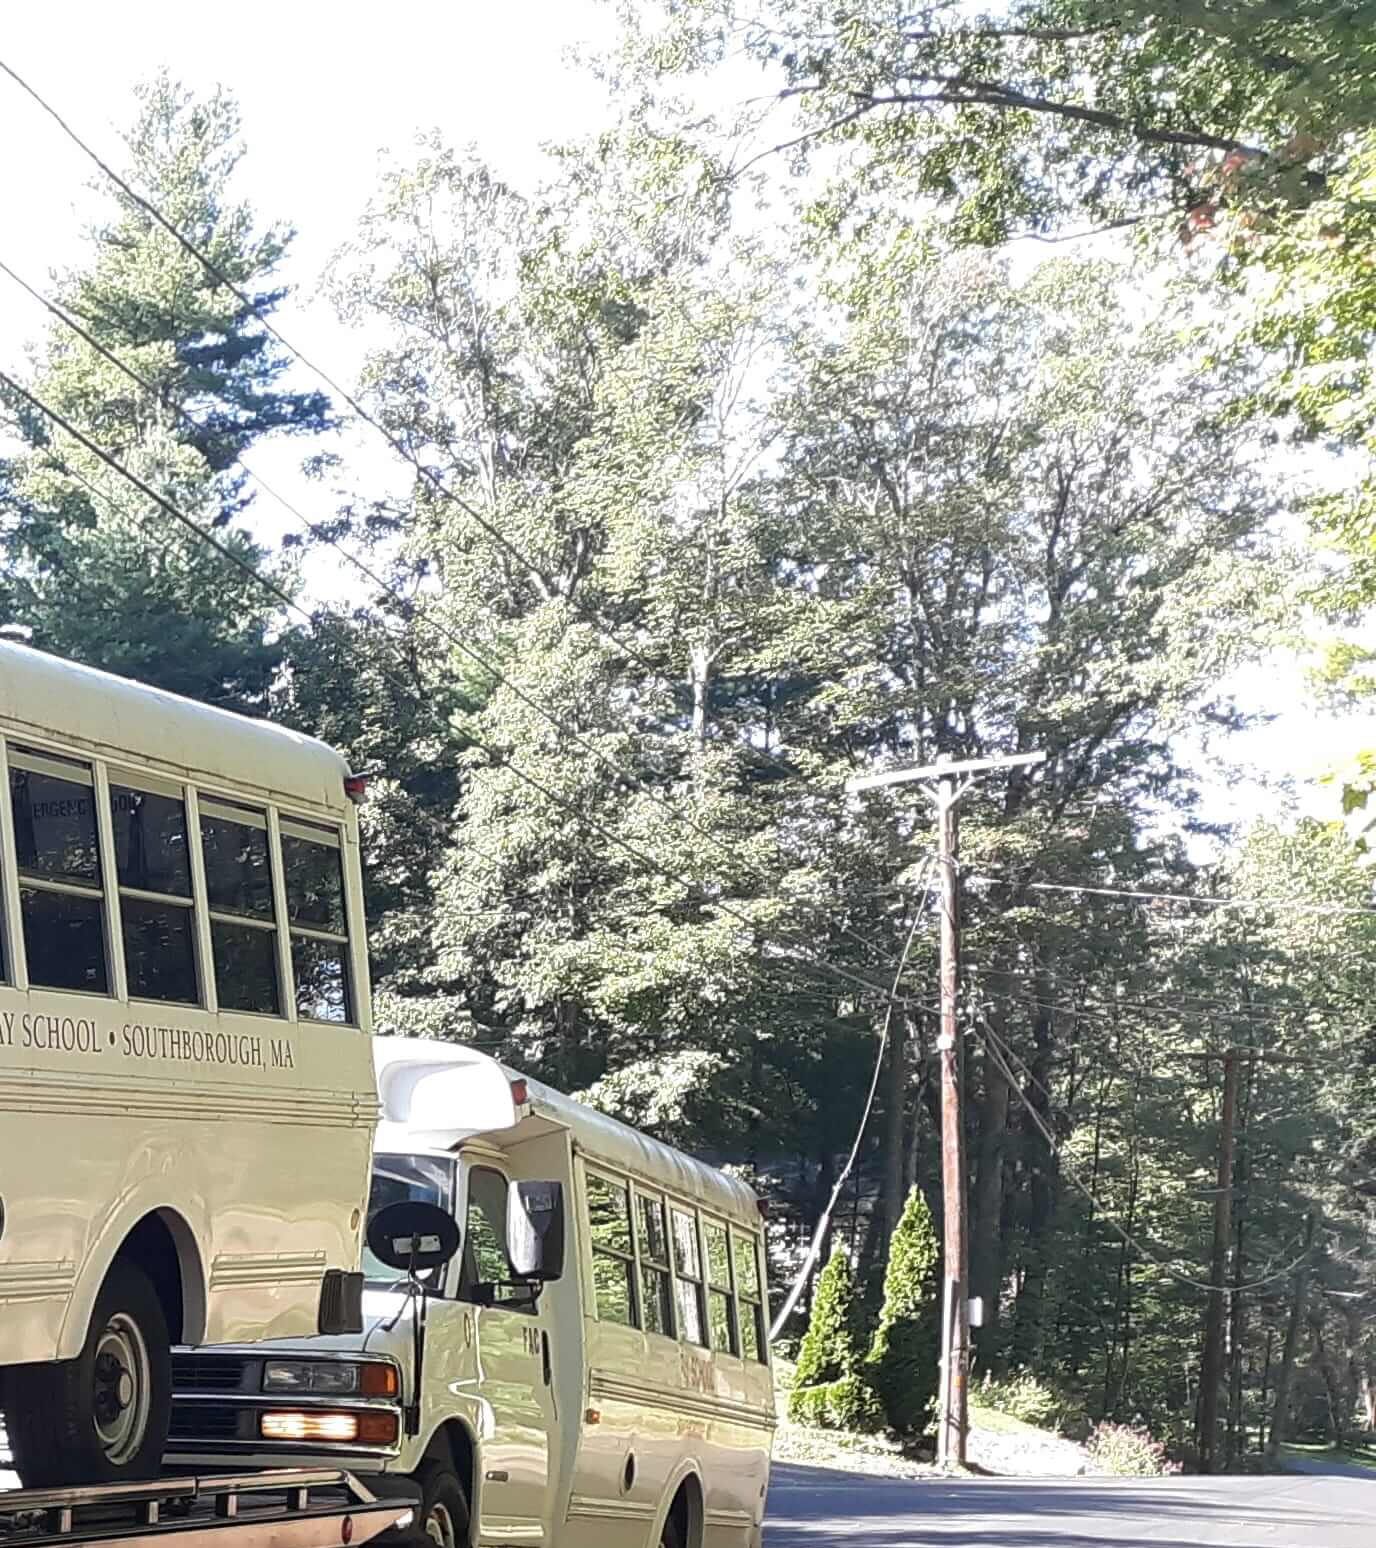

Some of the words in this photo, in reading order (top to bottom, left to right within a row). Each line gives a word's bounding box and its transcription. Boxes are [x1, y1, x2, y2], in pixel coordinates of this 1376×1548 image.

[22, 1014, 102, 1053] SCHOOL
[122, 1023, 267, 1072] SOUTHBOROUGH,
[271, 1039, 294, 1068] MA
